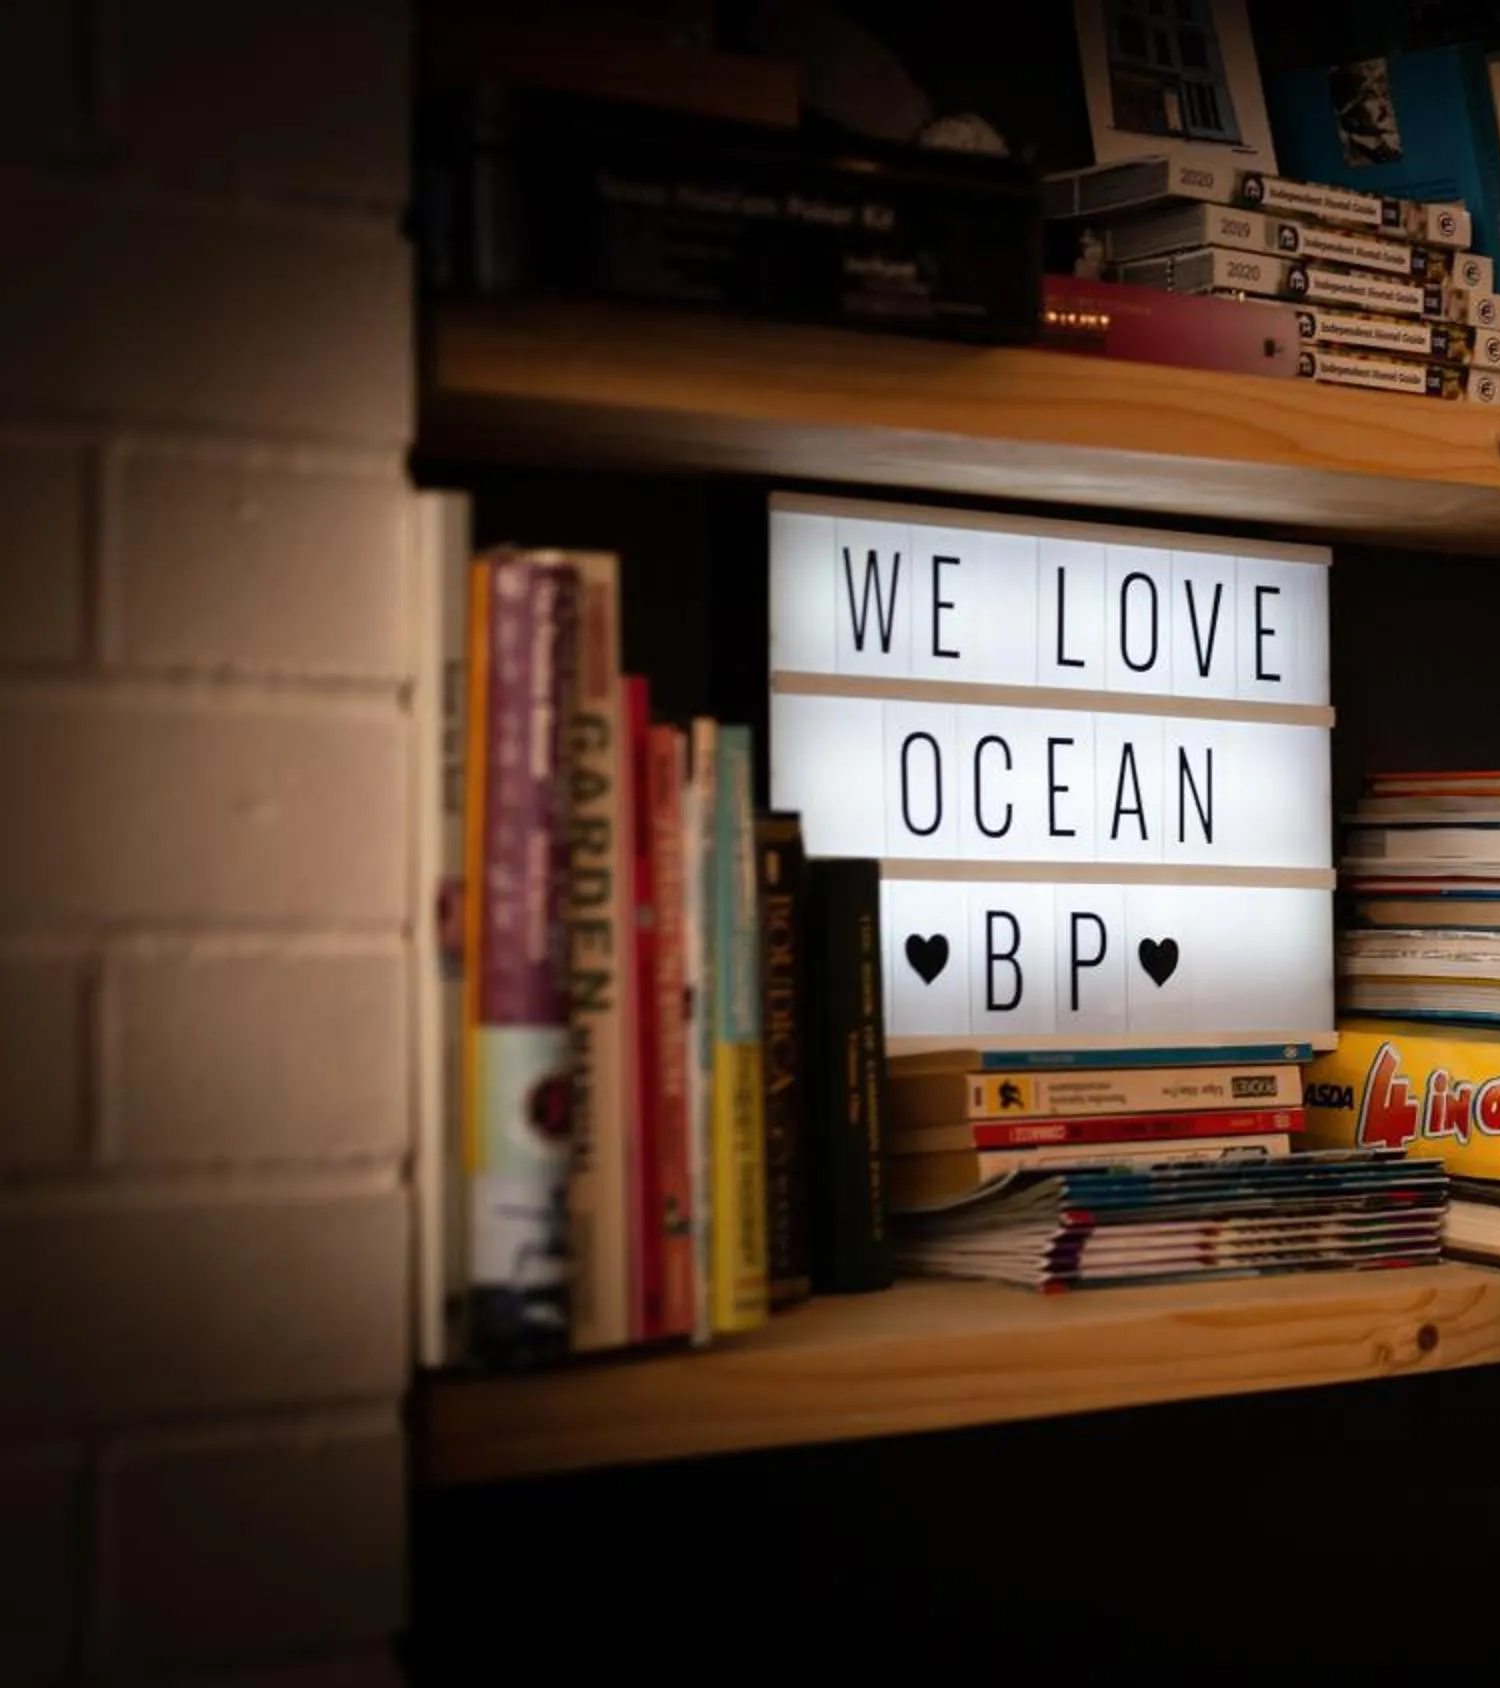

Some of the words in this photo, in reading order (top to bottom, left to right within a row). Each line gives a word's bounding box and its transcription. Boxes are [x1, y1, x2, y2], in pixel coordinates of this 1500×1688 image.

[1180, 167, 1214, 189] 2020
[1269, 188, 1322, 205] Independent
[1220, 217, 1251, 239] 2019
[1226, 261, 1262, 282] 2020
[1320, 322, 1372, 338] Independent
[843, 546, 961, 659] WE
[1057, 566, 1281, 683] LOVE
[900, 731, 1214, 844] OCEAN
[571, 713, 614, 1014] GARDEN
[985, 910, 1107, 1011] BP
[1303, 1082, 1354, 1111] ASDA
[1357, 1041, 1419, 1150] 4
